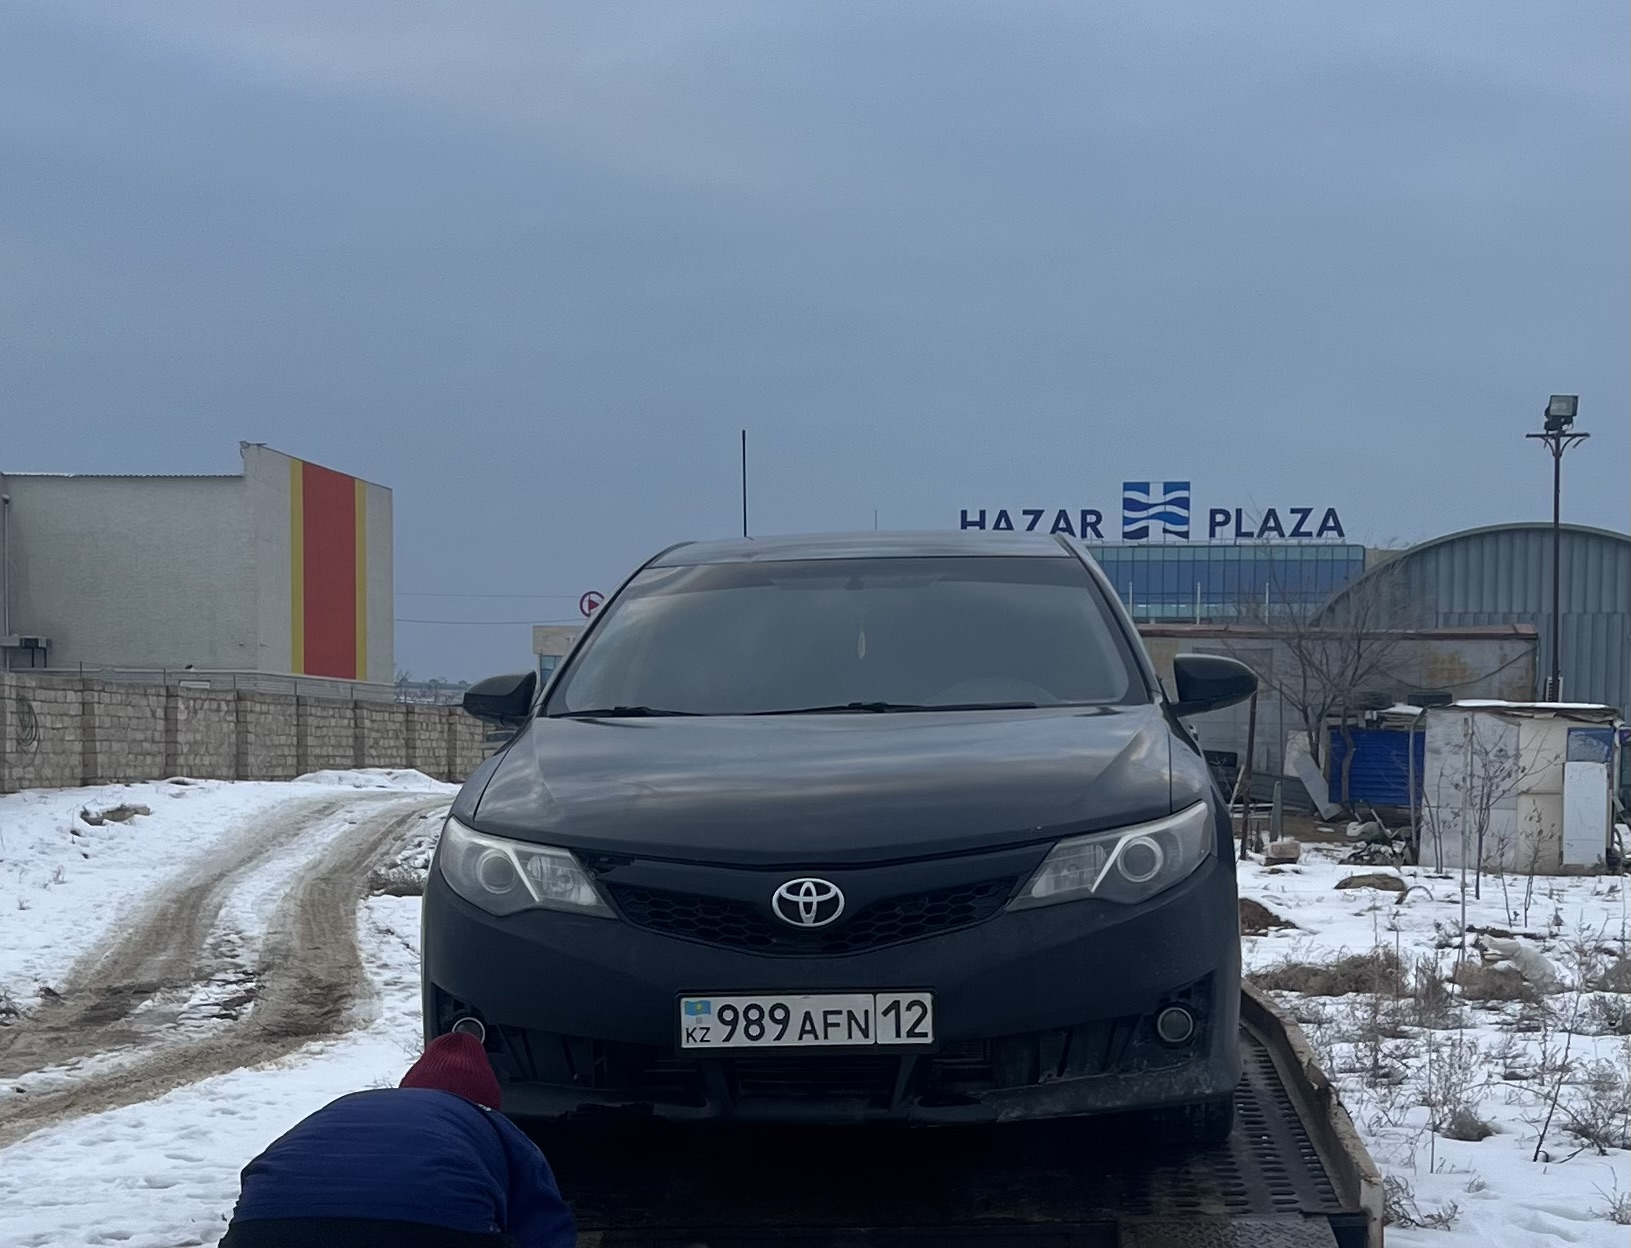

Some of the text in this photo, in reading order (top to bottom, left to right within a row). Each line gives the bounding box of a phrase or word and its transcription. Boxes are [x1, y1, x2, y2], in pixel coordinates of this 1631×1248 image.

[960, 507, 1345, 539] HAZAR PLAZA
[685, 1026, 711, 1043] KZ
[717, 999, 929, 1042] 989 AFN 12
